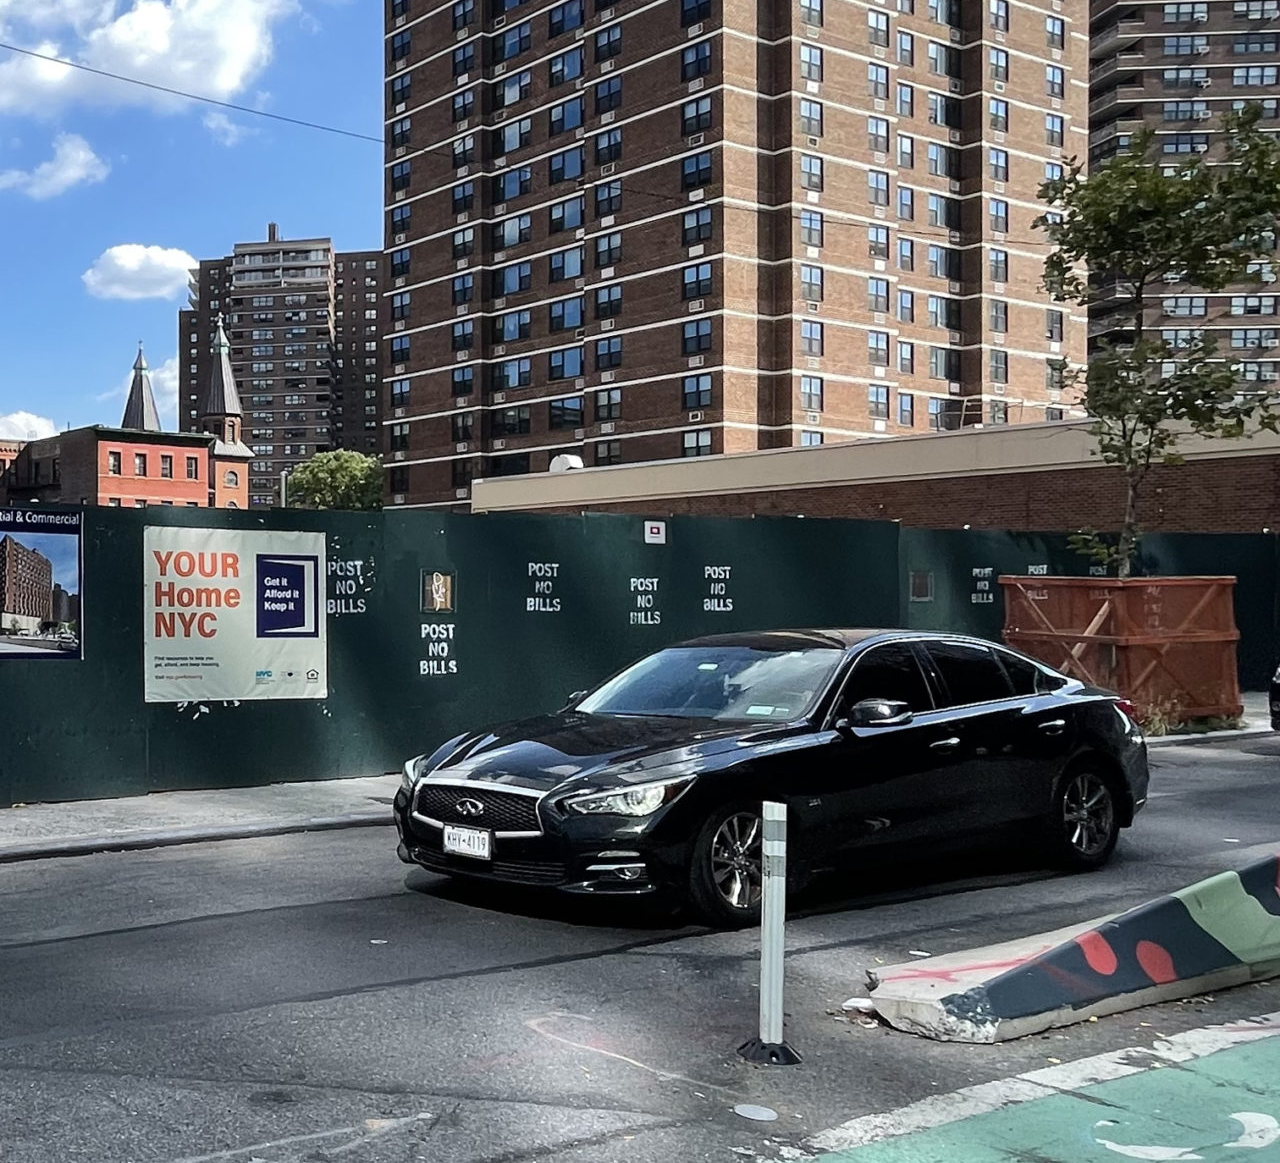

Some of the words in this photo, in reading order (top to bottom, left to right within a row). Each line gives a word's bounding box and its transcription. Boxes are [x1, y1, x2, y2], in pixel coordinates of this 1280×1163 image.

[16, 511, 23, 523] &
[25, 512, 79, 525] Commercial
[153, 550, 239, 578] YOUR
[327, 560, 363, 576] POST
[528, 562, 559, 577] POST
[1028, 564, 1048, 575] POST
[704, 566, 732, 579] POST
[264, 577, 280, 586] Get
[281, 577, 288, 586] it
[336, 580, 356, 595] NO
[535, 581, 553, 594] NO
[630, 578, 659, 592] POST
[710, 583, 726, 595] NO
[155, 581, 241, 608] Home
[264, 589, 292, 598] Afford
[292, 589, 300, 598] it
[637, 594, 653, 608] NO
[264, 601, 287, 612] Keep
[288, 601, 295, 611] it
[327, 598, 367, 614] BILLS
[526, 597, 561, 612] BILLS
[703, 598, 733, 611] BILLS
[155, 612, 218, 638] NYC
[629, 610, 661, 625] BILLS
[421, 623, 456, 640] POST
[428, 641, 449, 657] NO
[419, 660, 458, 675] BILLS
